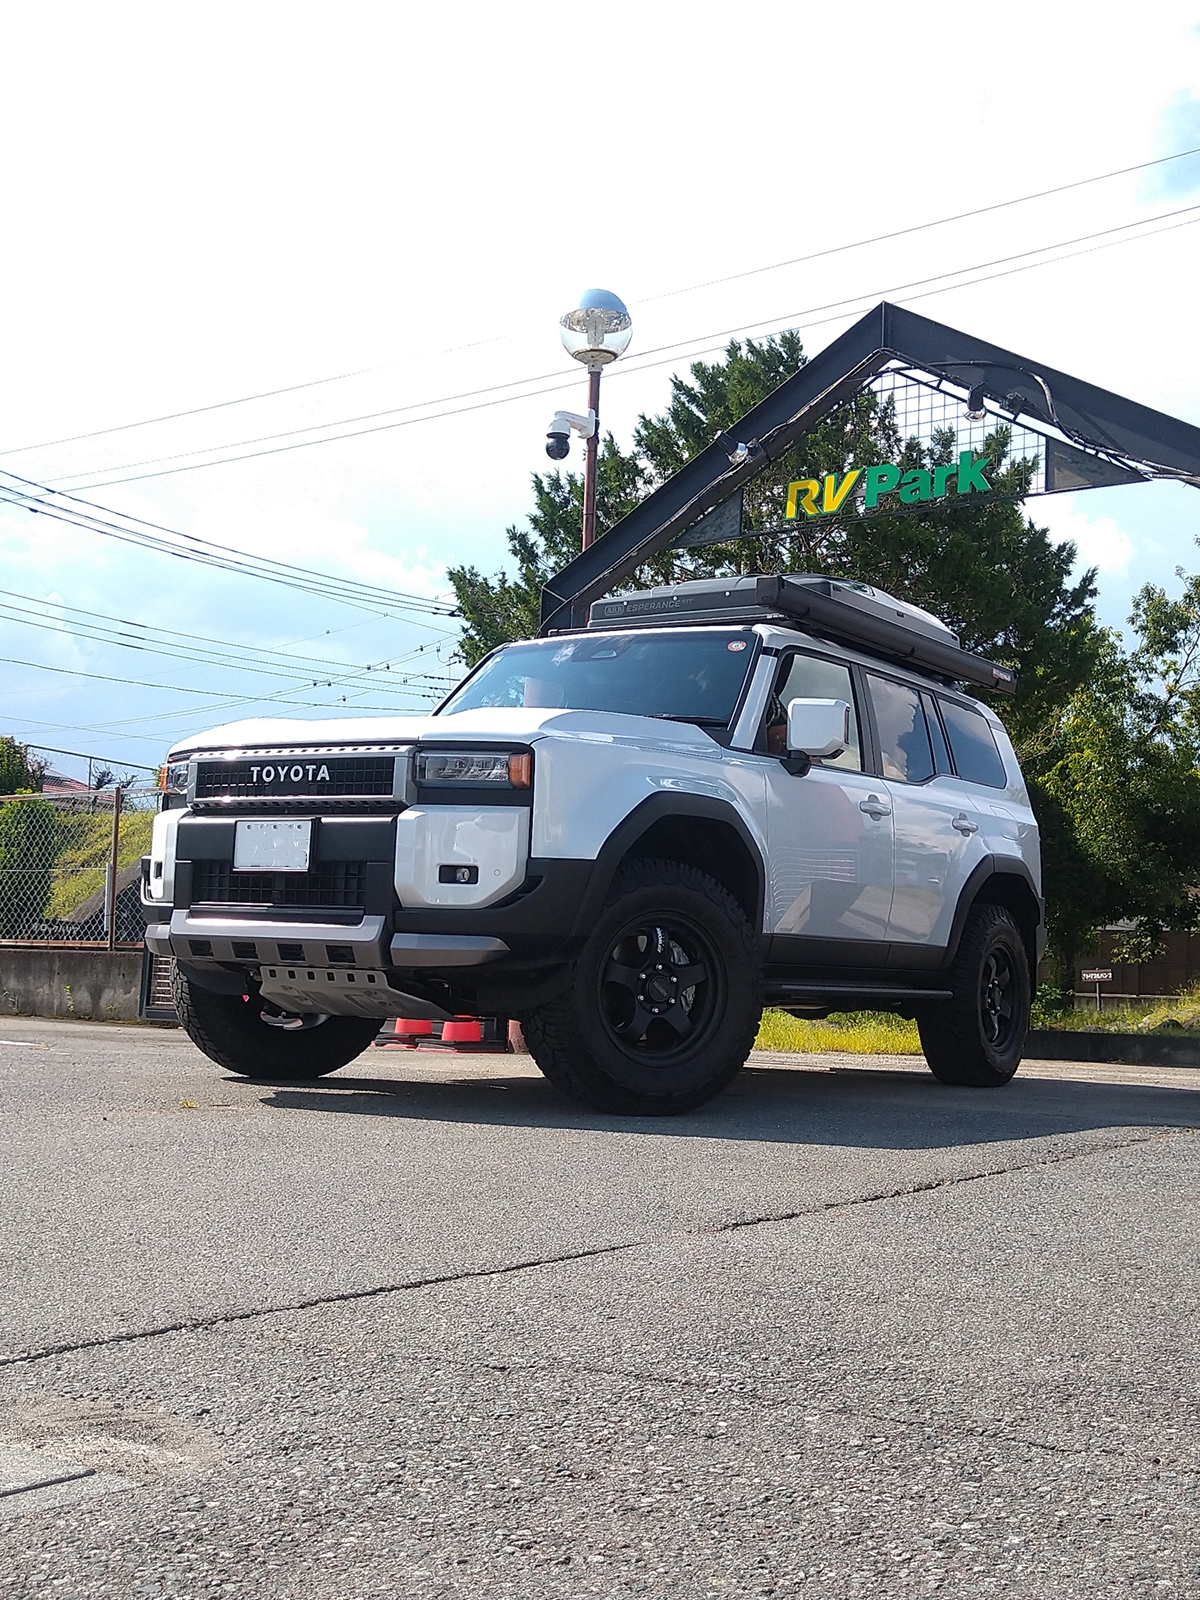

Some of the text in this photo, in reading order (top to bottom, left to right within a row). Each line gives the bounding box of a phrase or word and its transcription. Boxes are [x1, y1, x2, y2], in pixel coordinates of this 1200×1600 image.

[783, 450, 993, 520] RV Park
[626, 600, 680, 612] ESPERANCE
[250, 764, 330, 783] TOYOTA
